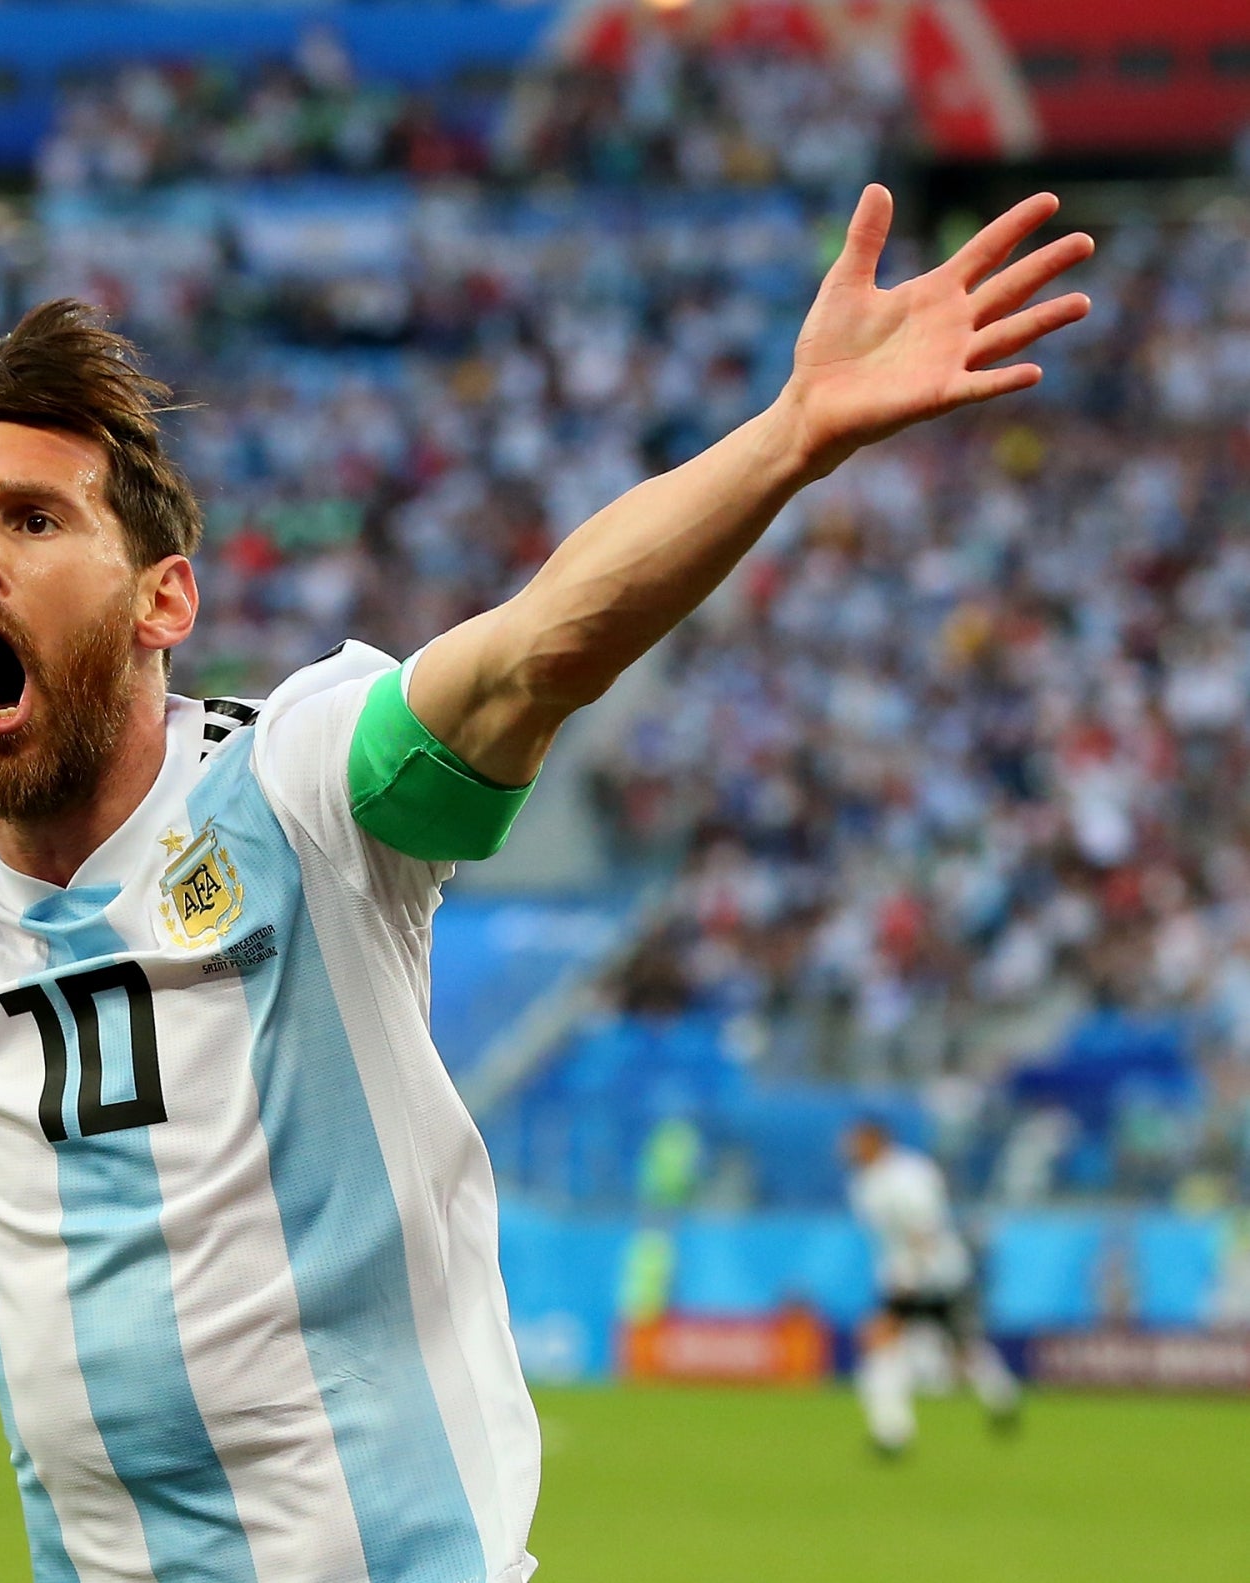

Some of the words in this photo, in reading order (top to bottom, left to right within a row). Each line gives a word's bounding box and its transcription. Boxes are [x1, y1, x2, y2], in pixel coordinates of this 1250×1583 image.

[181, 863, 221, 921] AFA
[228, 924, 276, 955] ARGENTINA
[243, 941, 265, 959] 2018
[202, 961, 229, 975] SAINT
